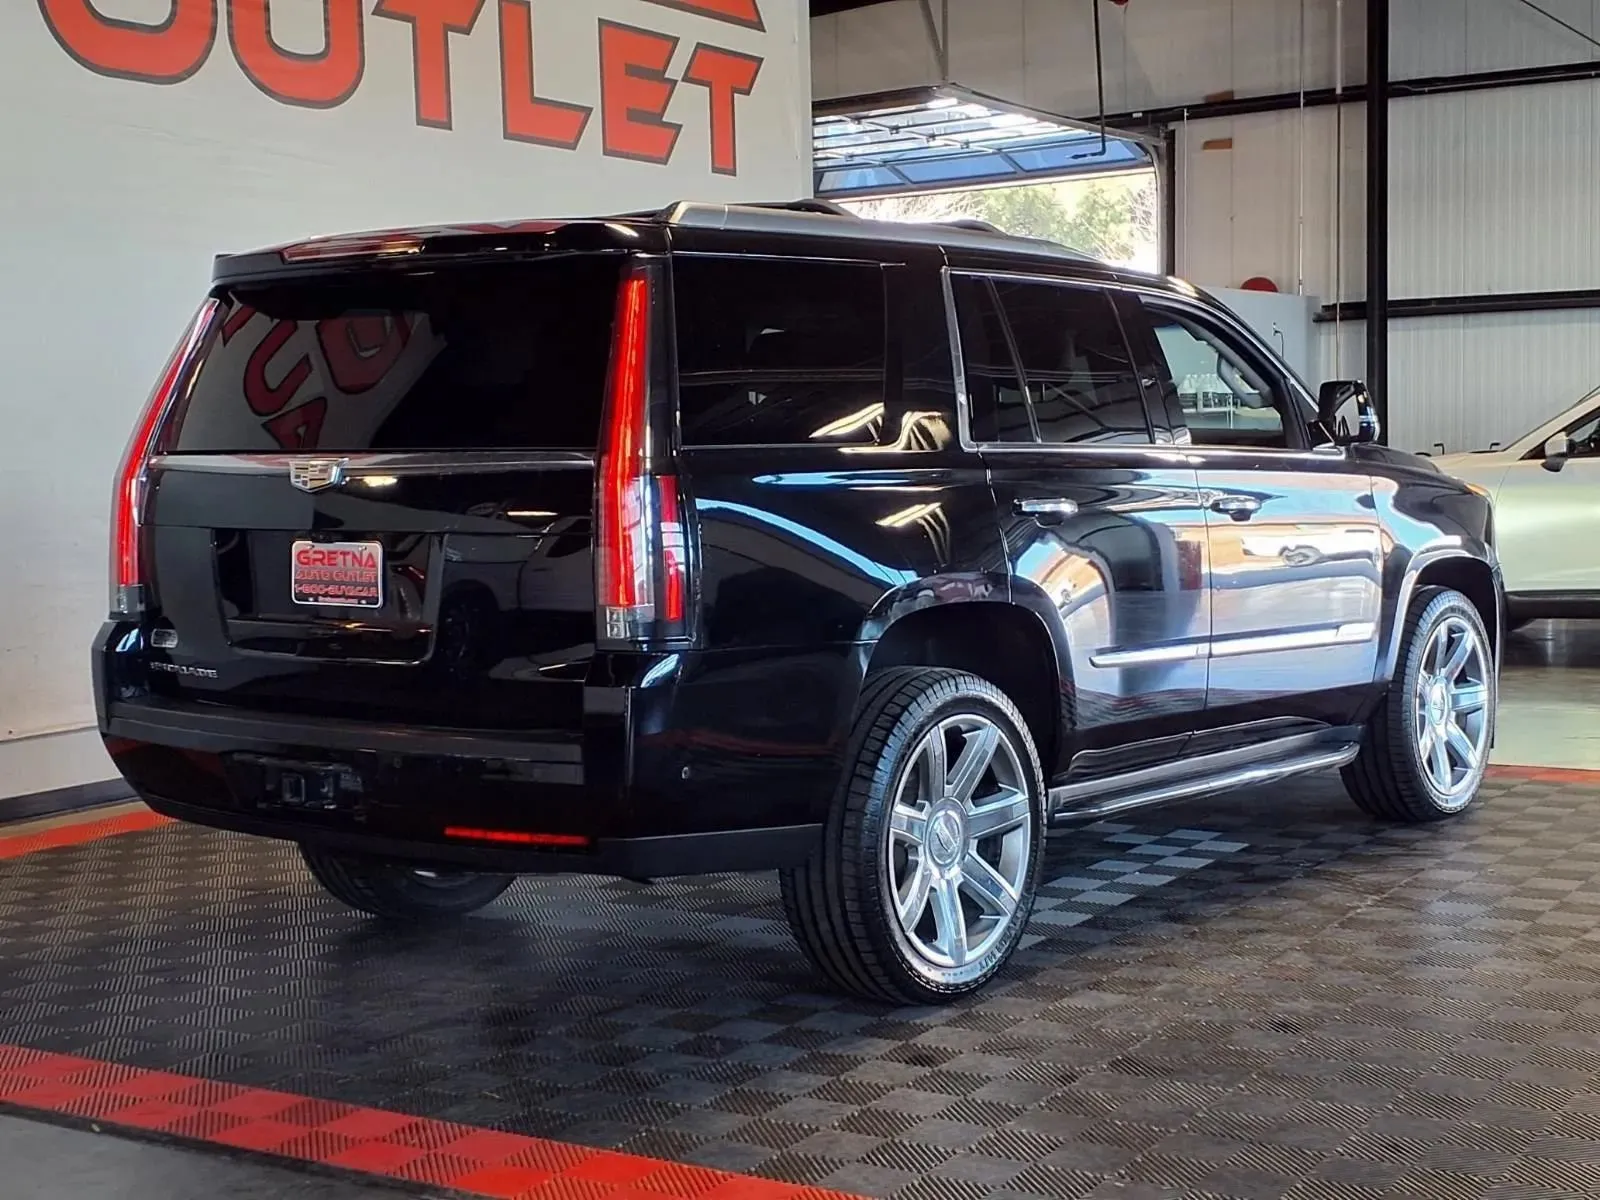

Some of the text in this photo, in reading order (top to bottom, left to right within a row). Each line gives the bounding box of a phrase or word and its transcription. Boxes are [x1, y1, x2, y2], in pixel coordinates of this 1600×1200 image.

[296, 549, 377, 569] GRETNA
[295, 569, 377, 583] AUTO OUTLET
